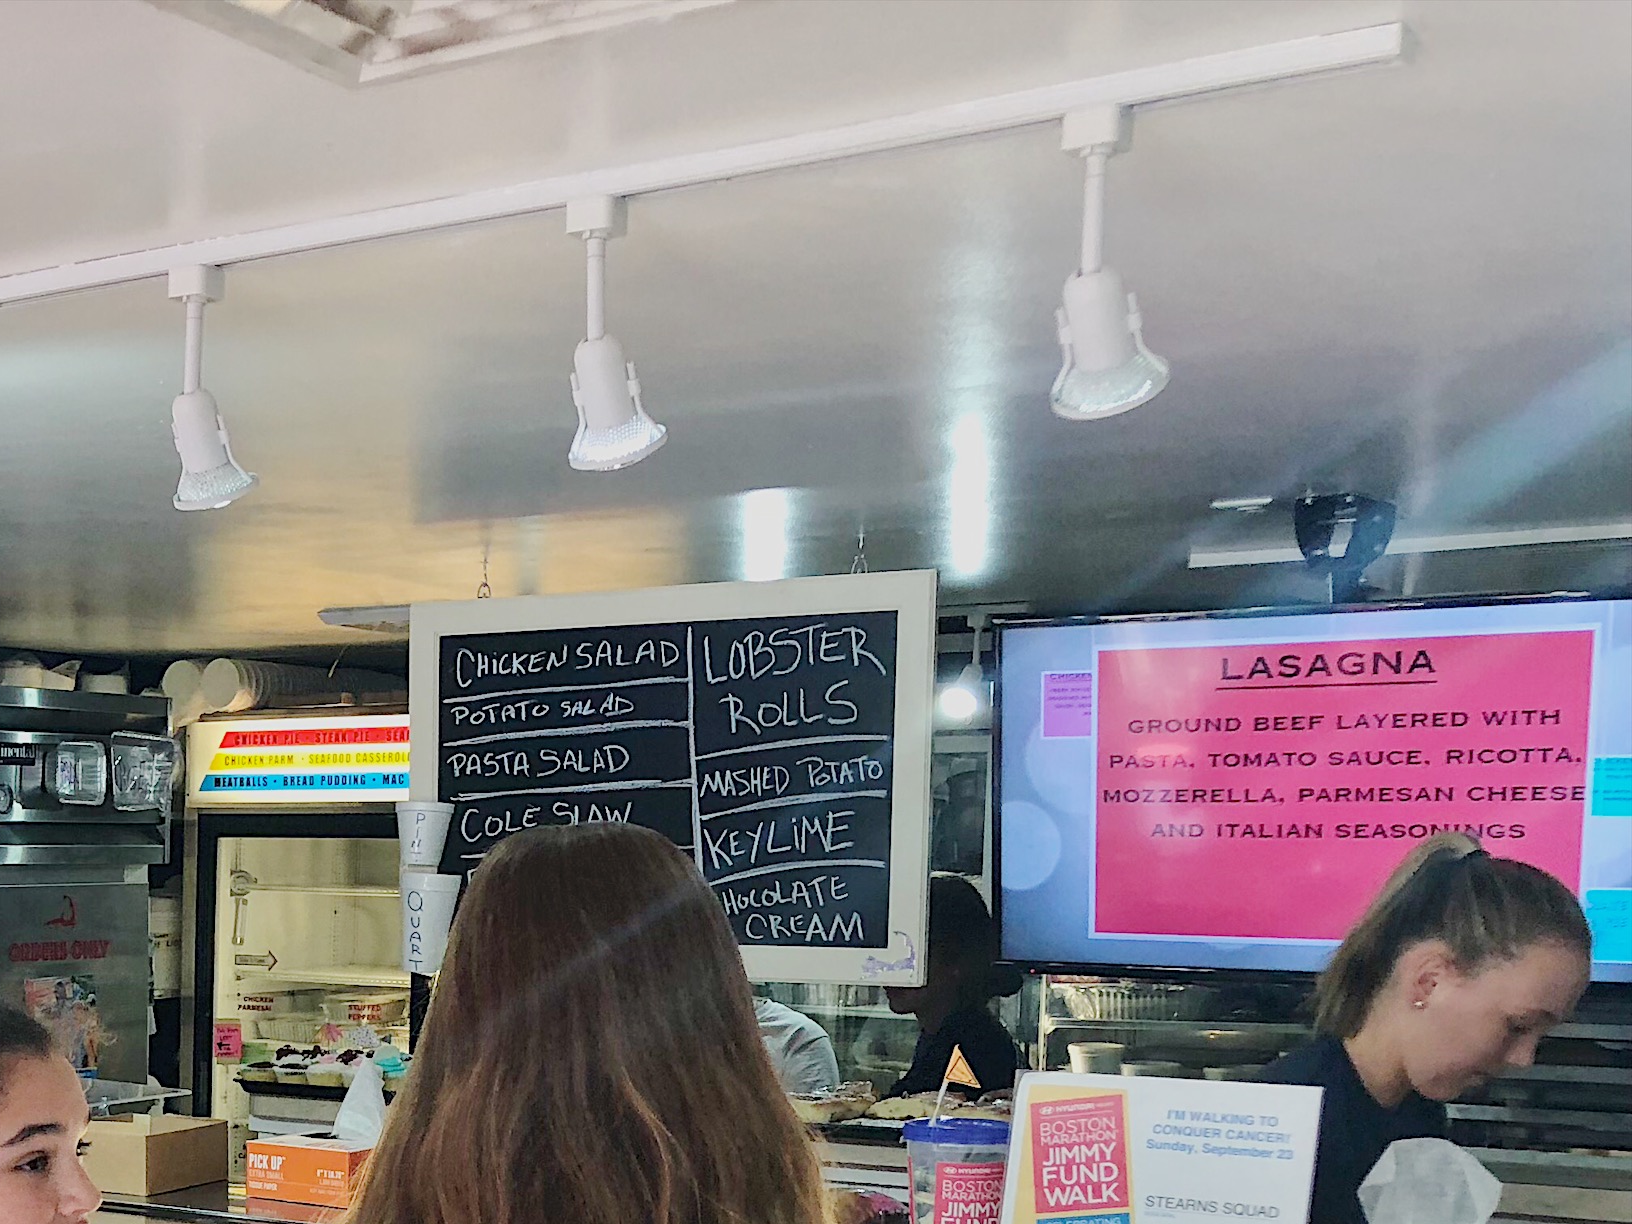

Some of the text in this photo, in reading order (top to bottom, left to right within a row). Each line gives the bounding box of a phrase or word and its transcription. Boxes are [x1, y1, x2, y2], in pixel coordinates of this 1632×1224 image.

[575, 639, 680, 671] SALAD
[703, 621, 887, 685] LOBSTER
[1219, 650, 1437, 682] LASAGNA
[450, 692, 635, 725] POTATO SALAD
[718, 679, 858, 736] ROLLS
[1127, 709, 1562, 735] GROUND BEEF LAYERED WITH
[233, 734, 278, 746] CHICKEN
[284, 733, 300, 745] PIE
[315, 732, 347, 744] STEAK
[353, 731, 370, 743] PIE
[224, 755, 265, 766] CHICKEN
[268, 755, 295, 766] PARM
[308, 753, 352, 765] SEAFOOD
[446, 744, 630, 779] PASTA SALAD
[1206, 751, 1318, 769] TOMATO
[213, 773, 406, 788] MEATBALLS BREAD PUDDING MAC
[699, 755, 885, 798] MASHED POTATO
[1102, 784, 1587, 807] MOZZERELLA, PARMESAN CHEESE
[460, 803, 542, 843] COLE
[1150, 823, 1206, 839] AND
[1216, 822, 1324, 839] ITALIAN
[720, 875, 850, 917] HOCOLATE
[407, 890, 425, 972] QUART
[745, 911, 866, 943] CREAM
[1039, 1116, 1117, 1138] BOSTON
[1152, 1123, 1222, 1139] CONQUER
[1189, 1111, 1256, 1126] WALKING
[1259, 1115, 1279, 1128] TO
[1040, 1130, 1117, 1147] MARATHON
[1201, 1142, 1274, 1159] September
[248, 1152, 269, 1170] PICK
[1042, 1142, 1117, 1167] JIMMY
[941, 1179, 1002, 1193] BOSTON
[1042, 1162, 1120, 1188] FUND
[1043, 1182, 1121, 1208] WALK
[1144, 1194, 1281, 1219] STEARNS SQUAD
[941, 1201, 1001, 1218] JIMMY
